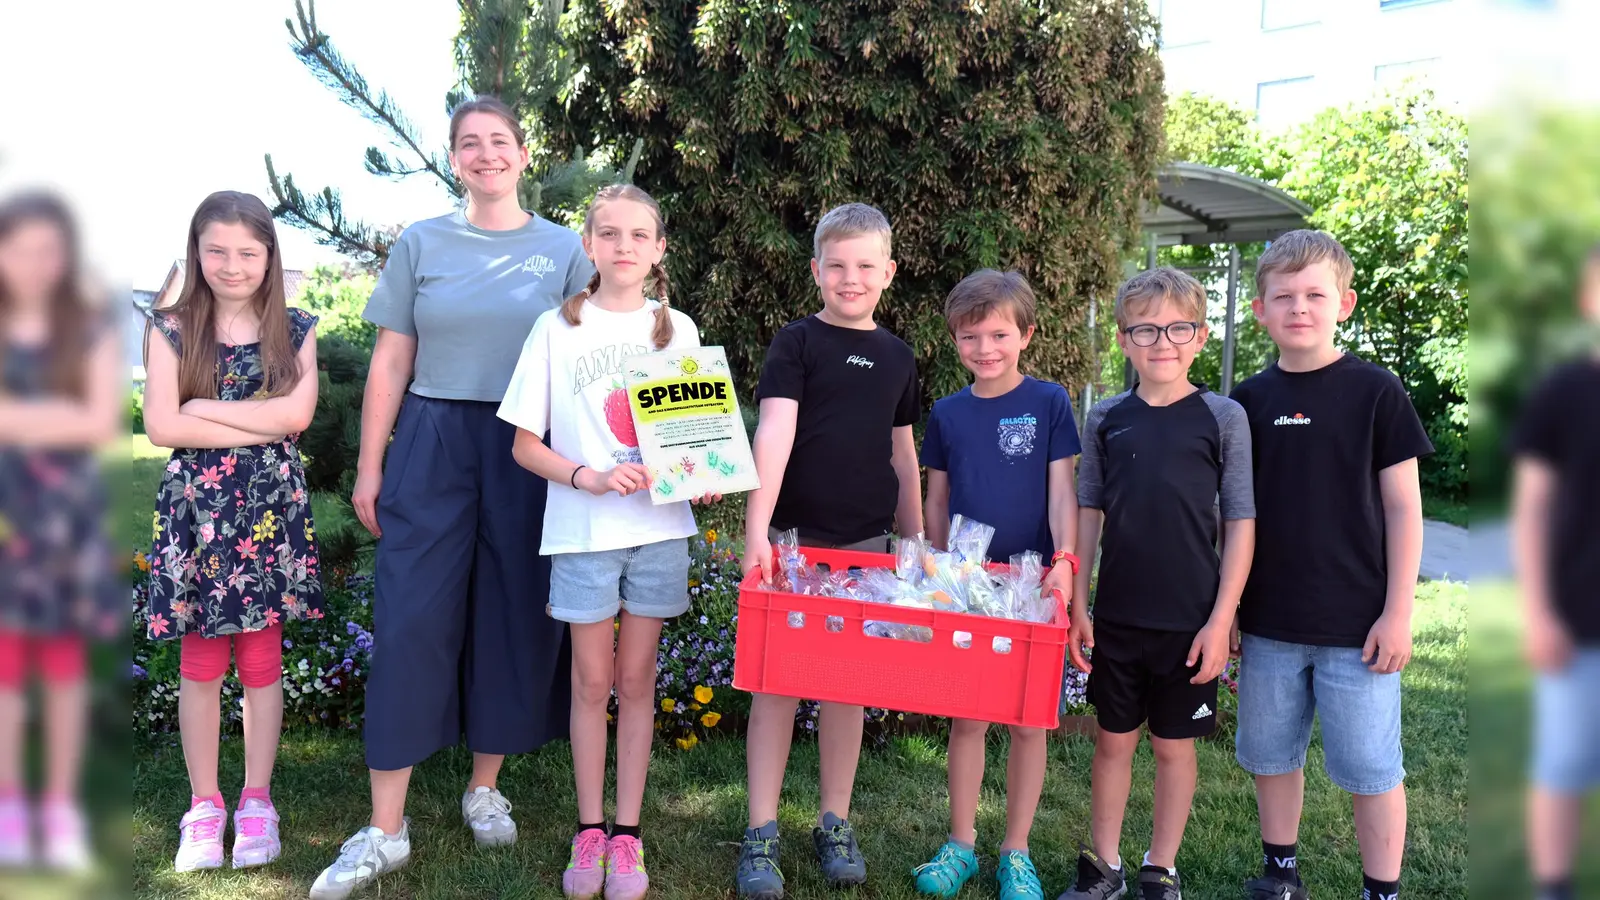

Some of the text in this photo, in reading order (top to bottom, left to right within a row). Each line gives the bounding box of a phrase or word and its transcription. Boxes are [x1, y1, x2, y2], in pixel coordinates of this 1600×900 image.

[525, 255, 554, 269] PUMA
[637, 382, 727, 408] SPENDE
[1000, 417, 1037, 425] GALACTIC
[1274, 415, 1311, 426] ellesse
